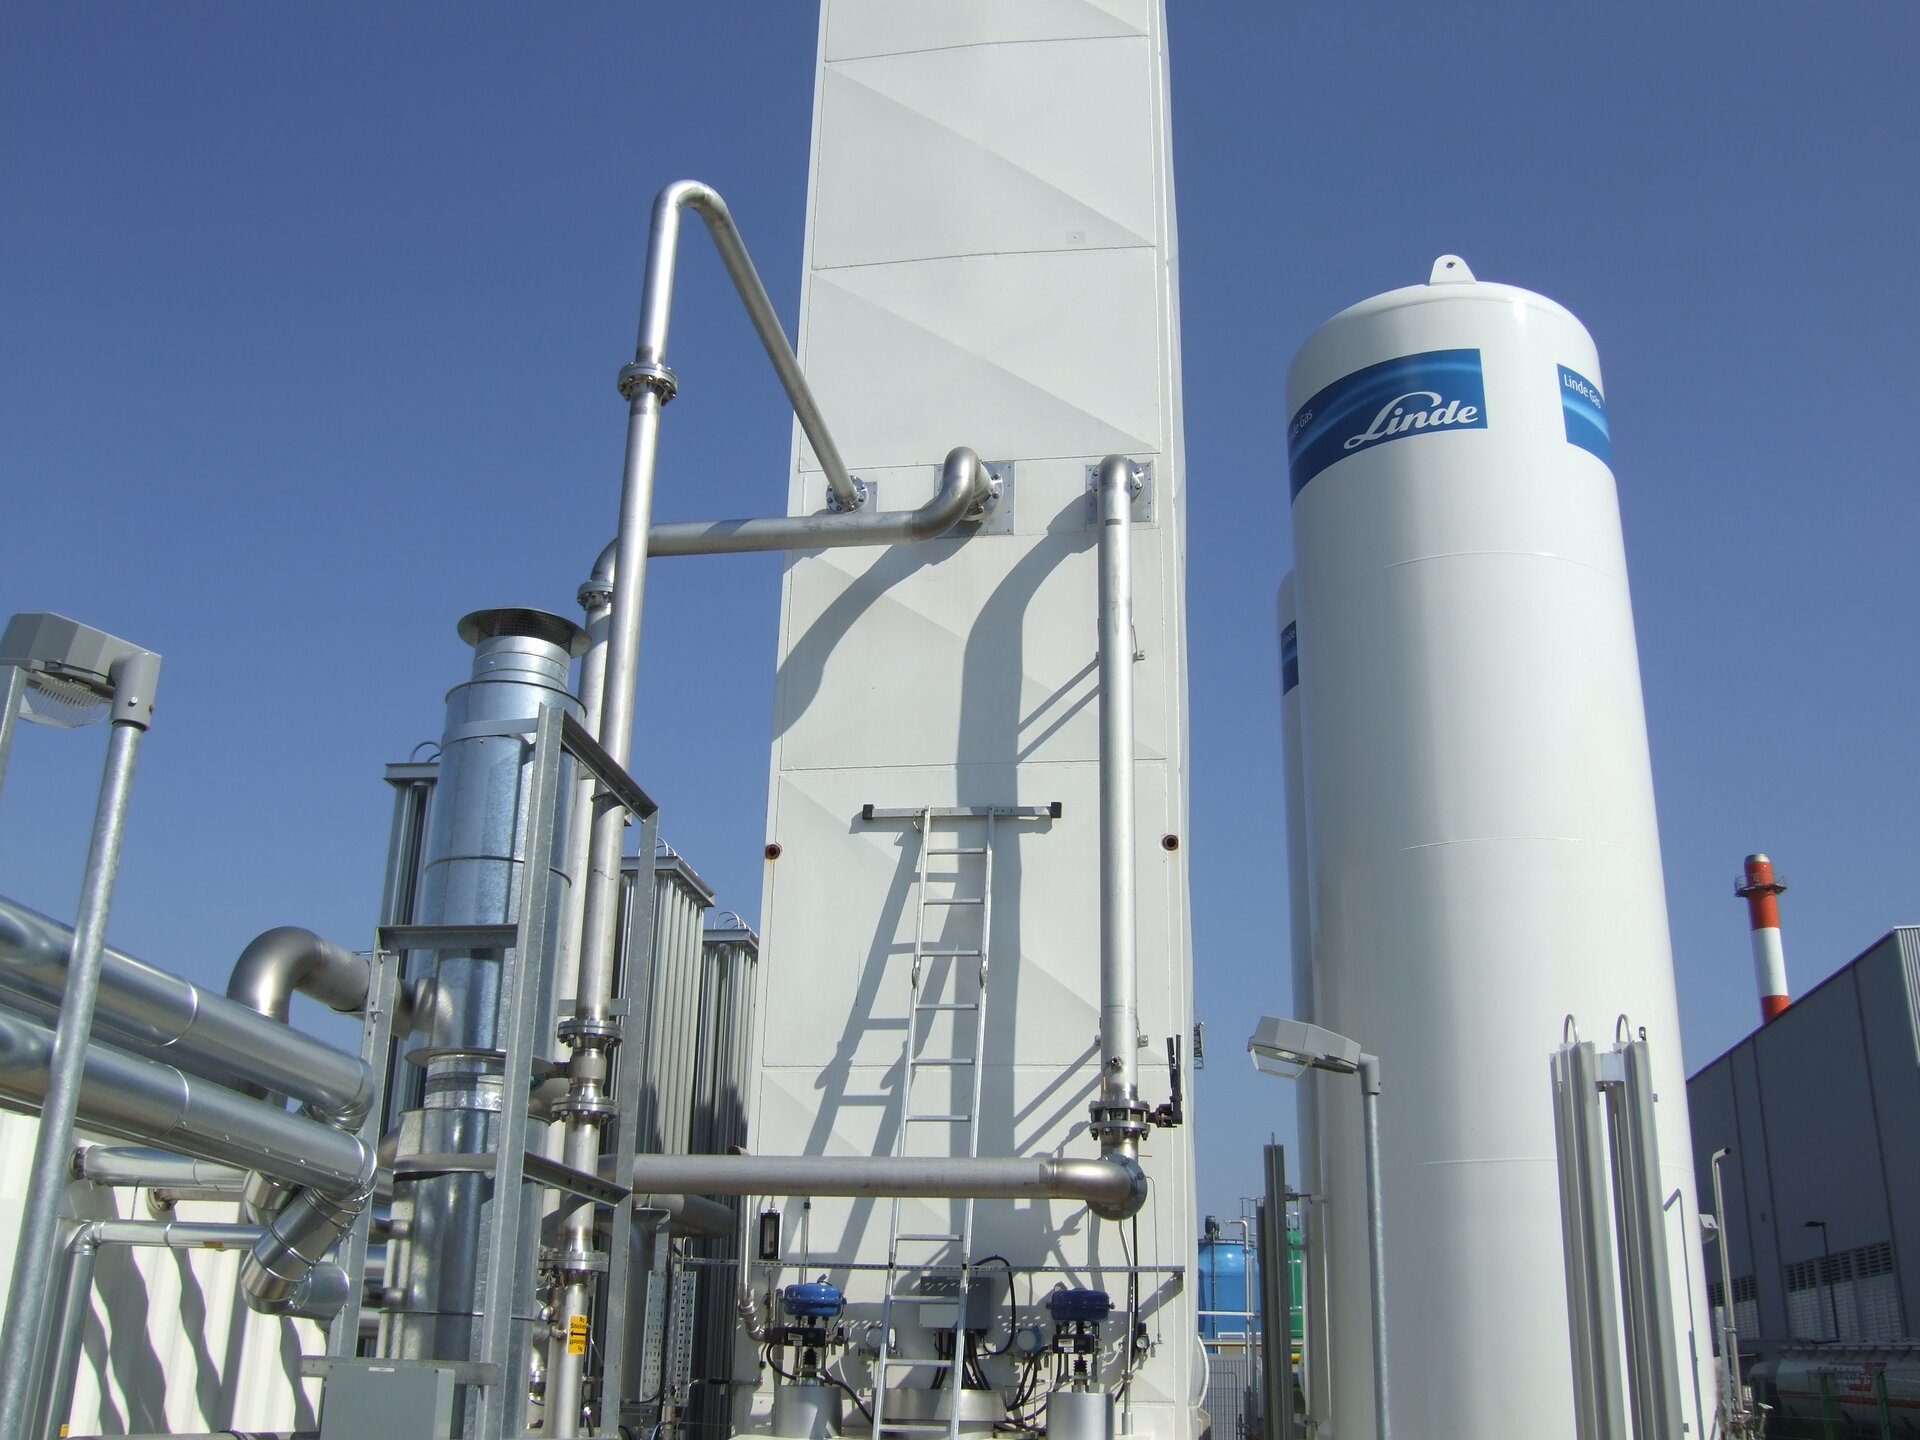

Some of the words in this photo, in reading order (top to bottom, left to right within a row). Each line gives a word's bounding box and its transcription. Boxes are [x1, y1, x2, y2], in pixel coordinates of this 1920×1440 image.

[1563, 373, 1589, 398] Linde
[1589, 389, 1601, 409] Gas
[1299, 408, 1313, 428] Gas
[1343, 391, 1479, 450] Linde
